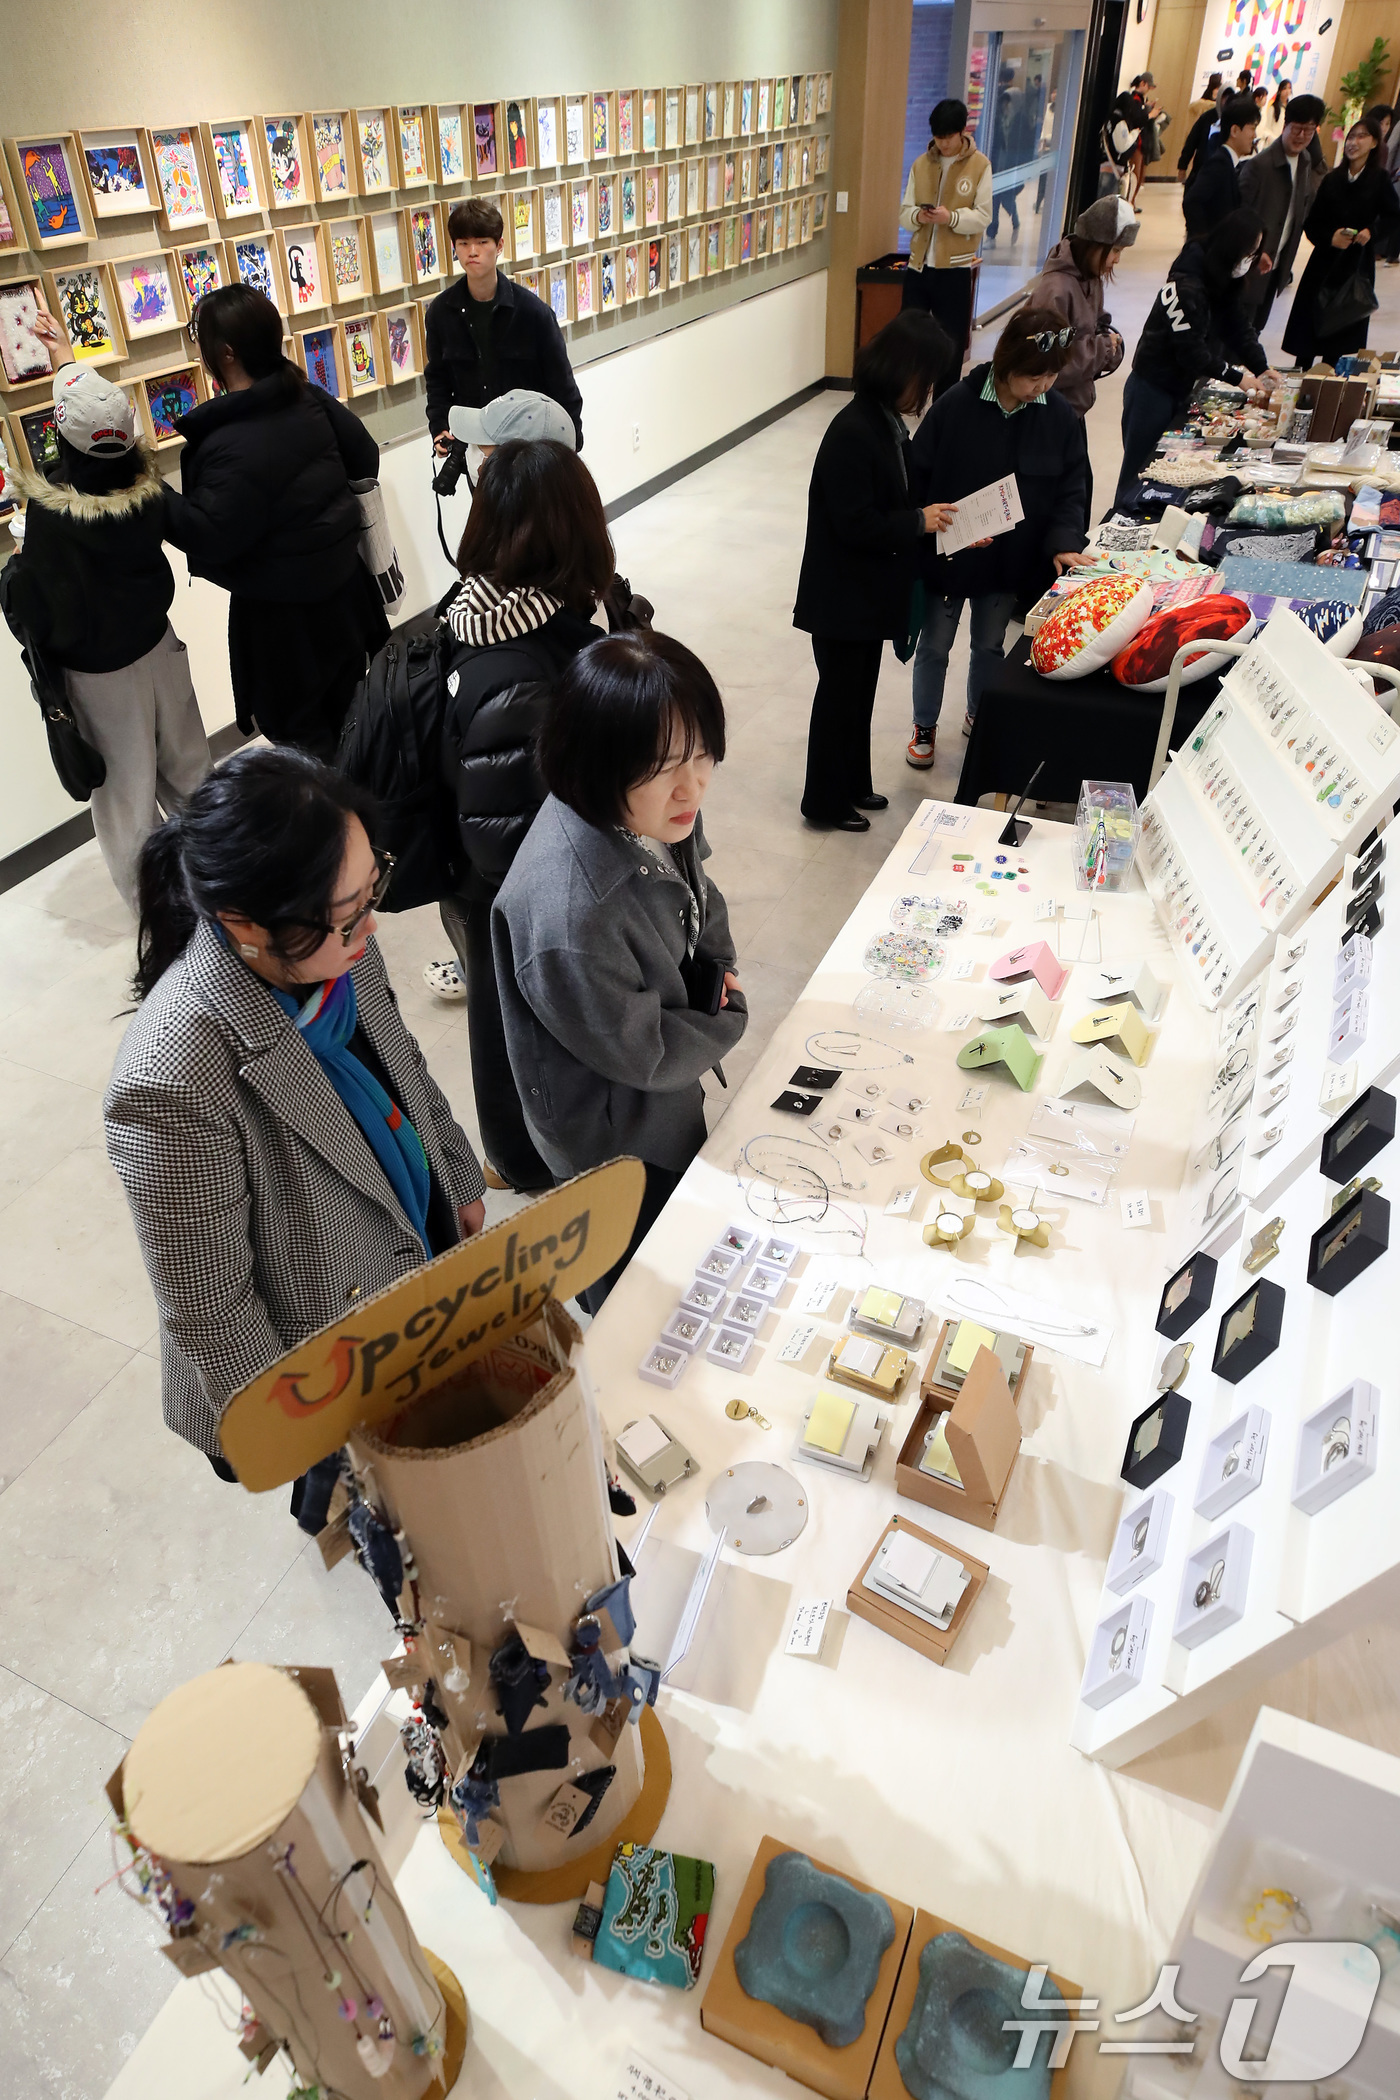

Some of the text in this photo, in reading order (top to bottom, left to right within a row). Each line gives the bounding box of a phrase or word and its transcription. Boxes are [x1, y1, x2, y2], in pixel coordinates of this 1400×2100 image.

[1245, 41, 1311, 86] ART
[268, 1209, 590, 1418] Upcycling
[385, 1275, 556, 1404] Jewelry
